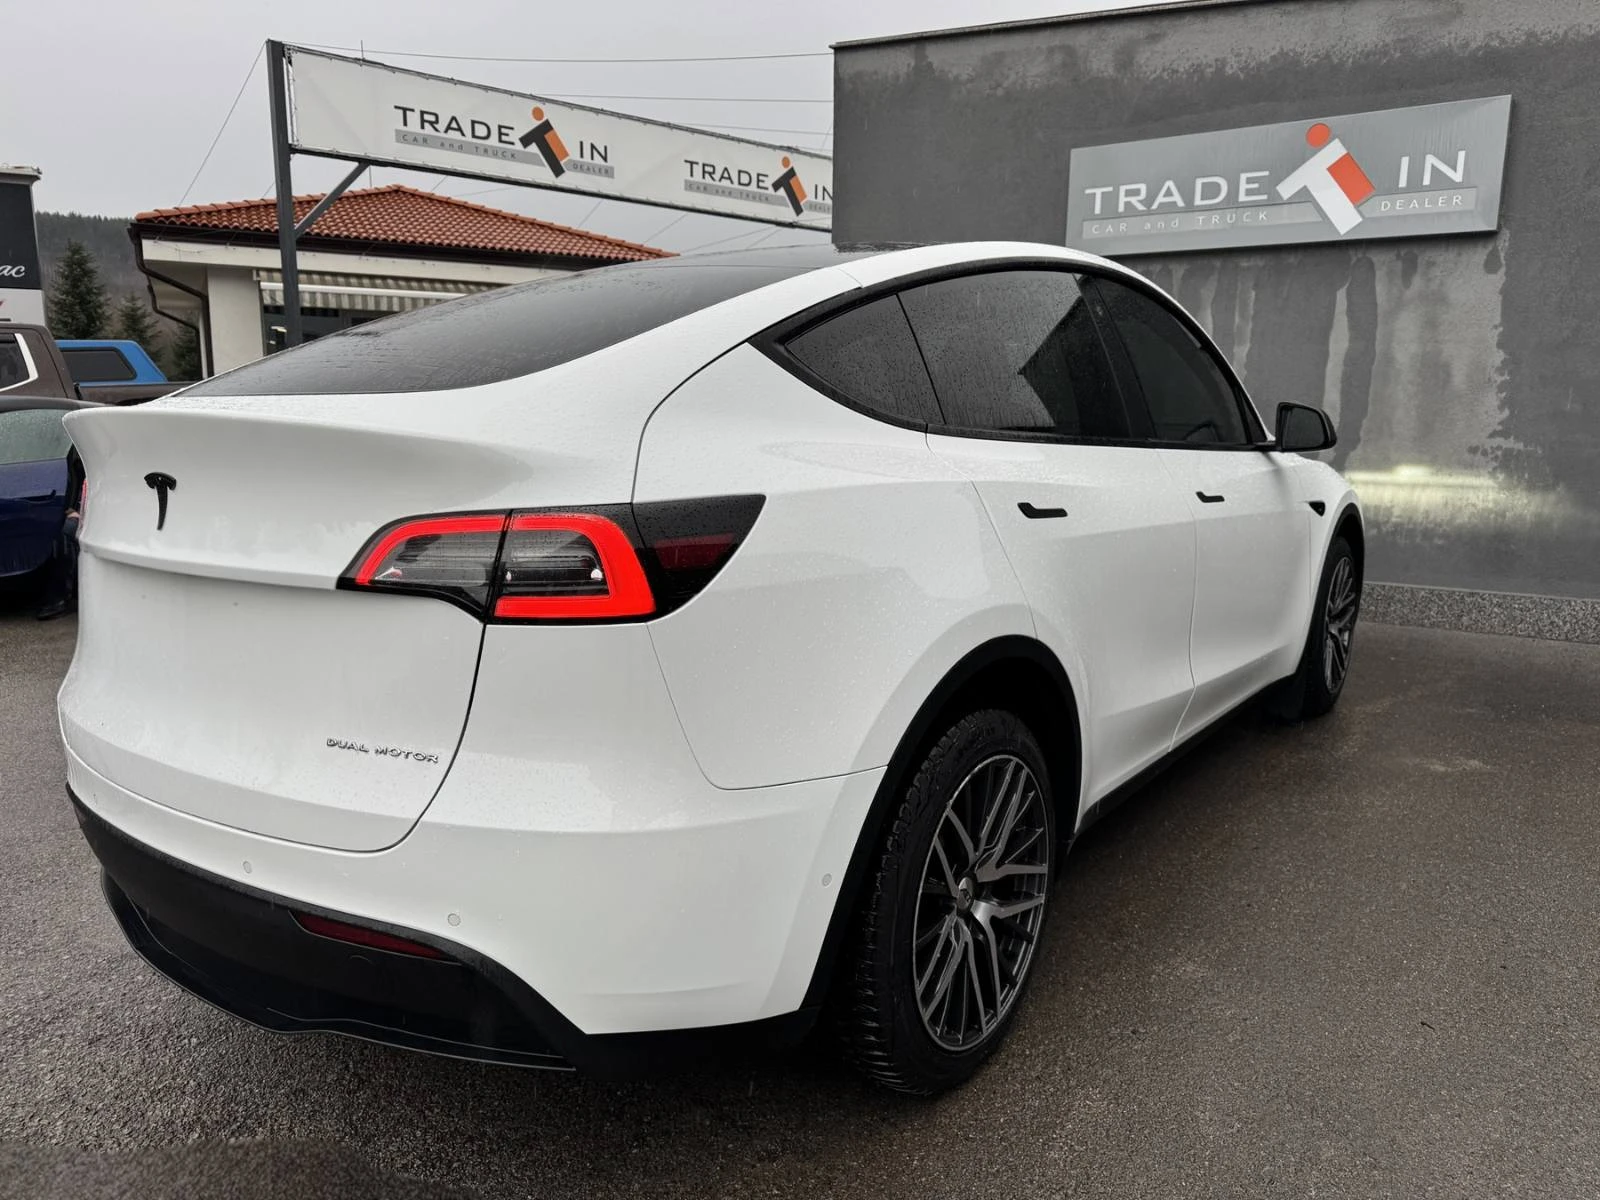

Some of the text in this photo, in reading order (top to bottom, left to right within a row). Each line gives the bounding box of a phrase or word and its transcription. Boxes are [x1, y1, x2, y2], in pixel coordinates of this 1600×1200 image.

[394, 105, 516, 145] TRADE
[579, 140, 609, 163] IN
[402, 134, 429, 145] CAR
[475, 146, 517, 159] TRUCK
[572, 163, 609, 175] DEALER
[684, 159, 769, 191] TRADE
[1084, 170, 1270, 215] TRADE
[1398, 150, 1466, 188] IN
[1091, 195, 1464, 235] CAR and TRUCK DEALER
[326, 738, 439, 764] DUAL MOTOR
